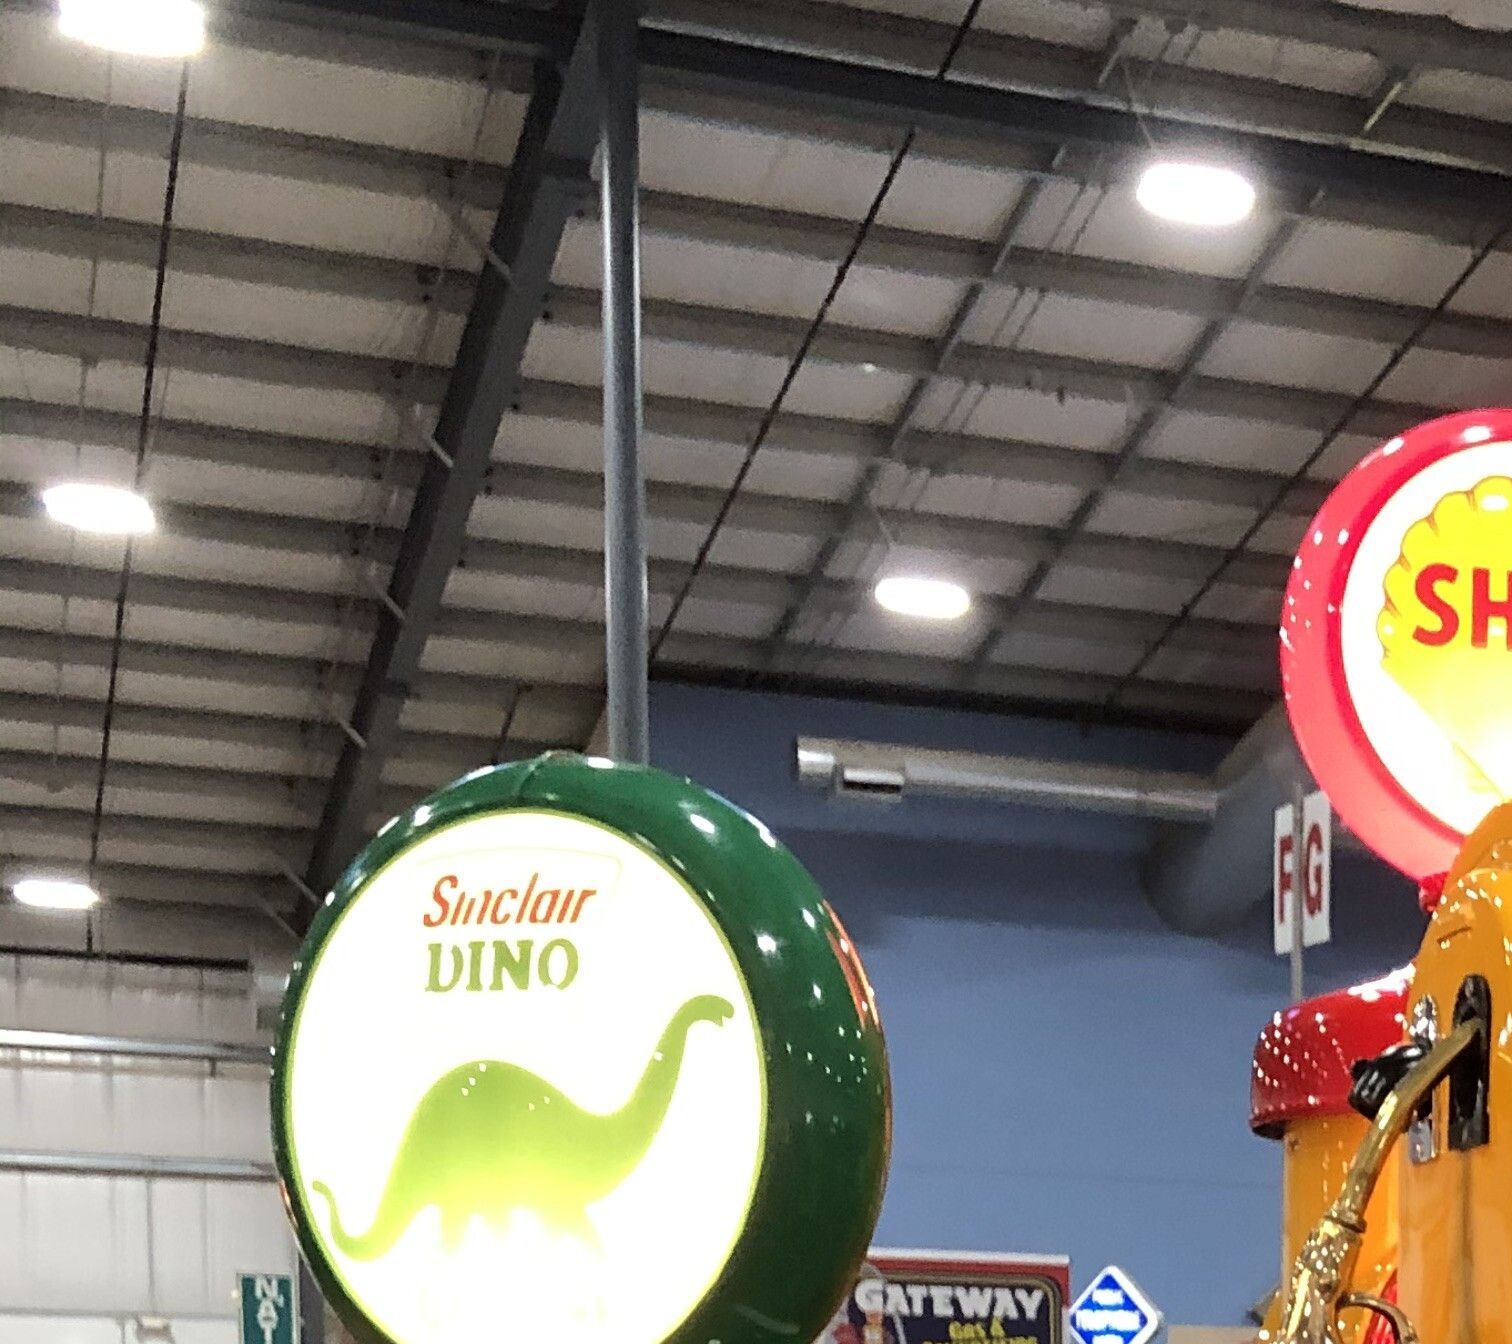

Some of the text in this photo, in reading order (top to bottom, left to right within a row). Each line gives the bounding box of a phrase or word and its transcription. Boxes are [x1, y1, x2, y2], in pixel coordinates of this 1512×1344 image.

[423, 872, 597, 928] Sinclair
[424, 938, 579, 993] DINO
[855, 1279, 1044, 1321] GATEWAY
